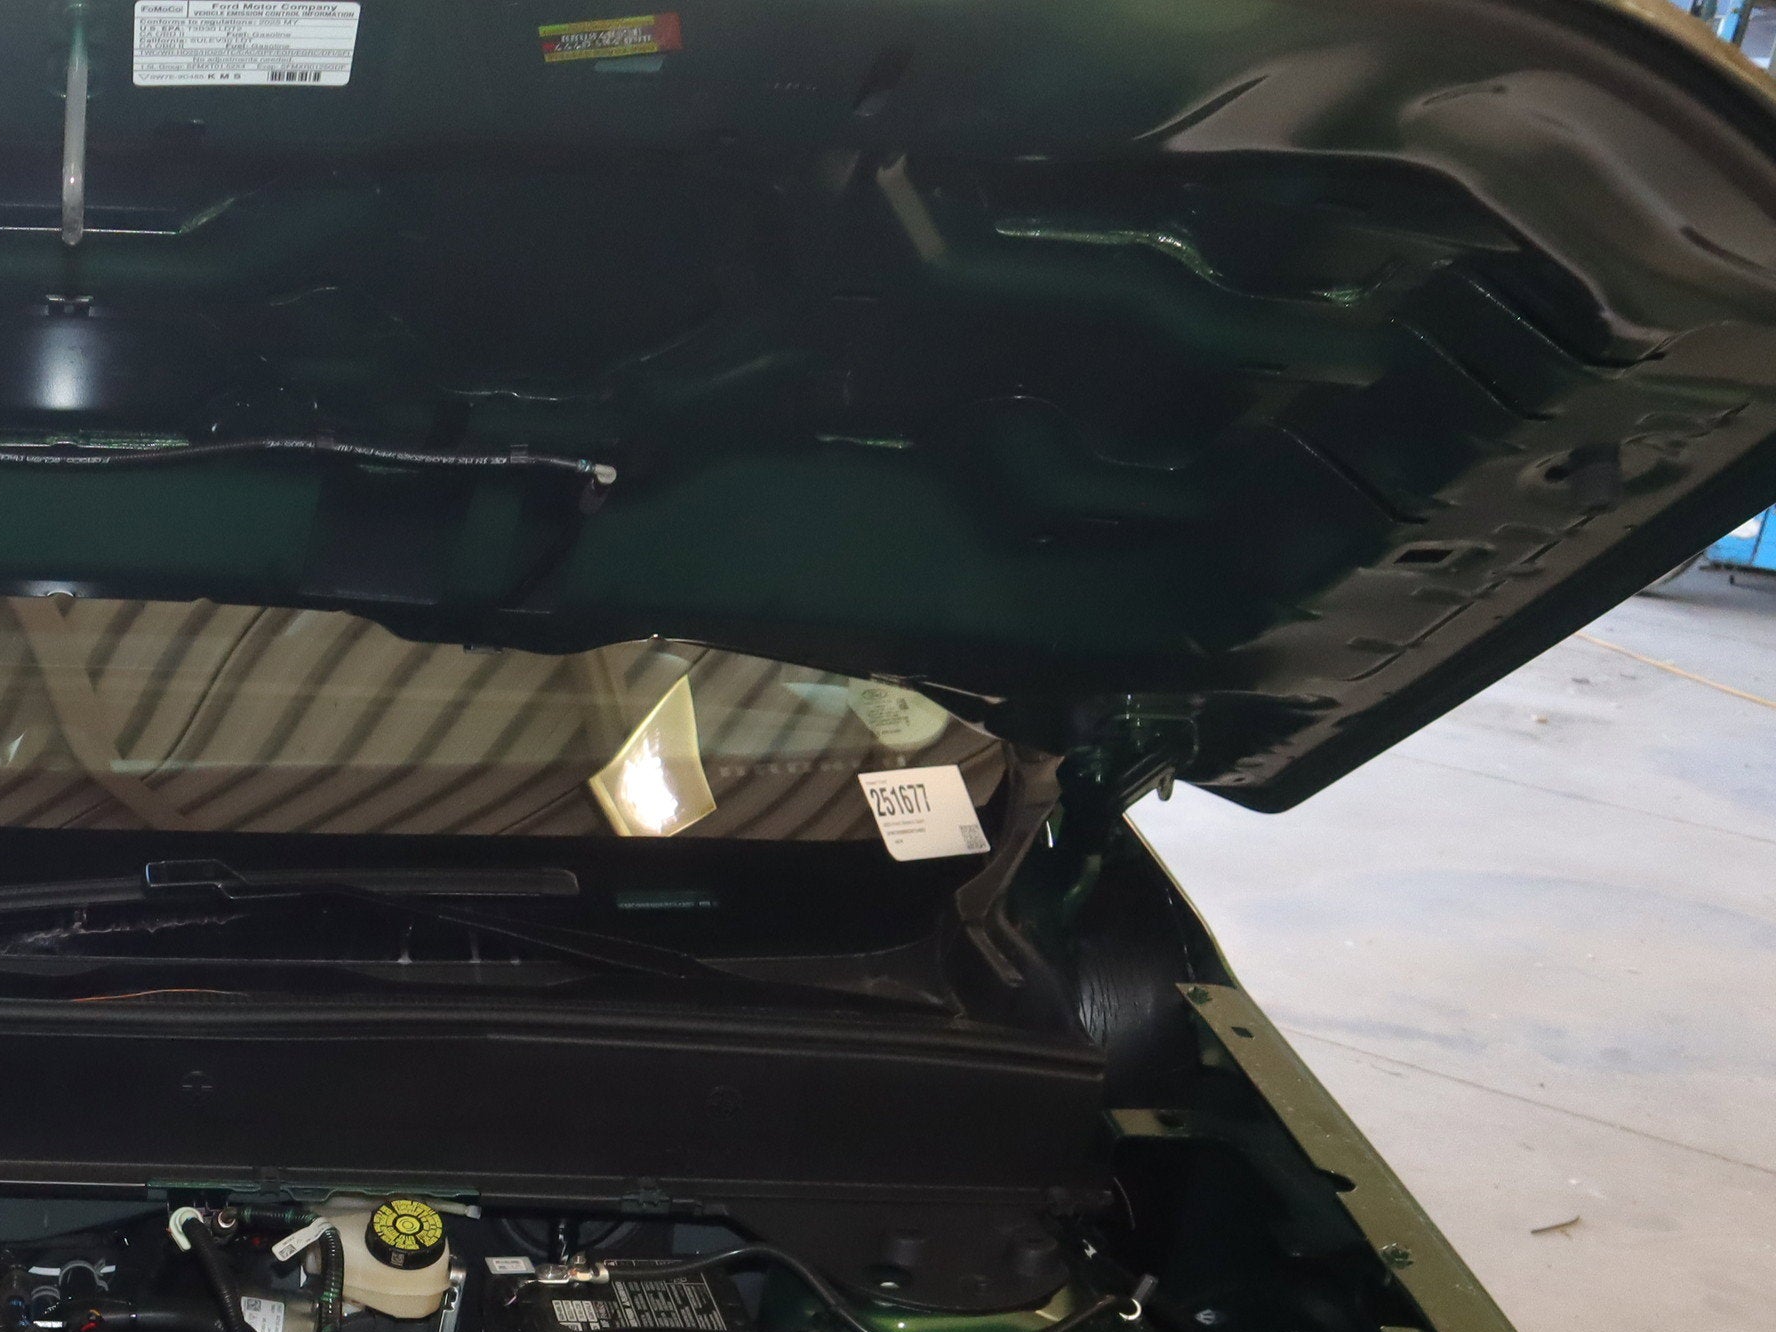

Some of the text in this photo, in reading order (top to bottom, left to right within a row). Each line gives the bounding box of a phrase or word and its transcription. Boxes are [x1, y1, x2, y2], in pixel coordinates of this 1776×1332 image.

[141, 5, 183, 13] FoMoCo
[281, 3, 338, 12] Company
[869, 783, 931, 817] 251677
